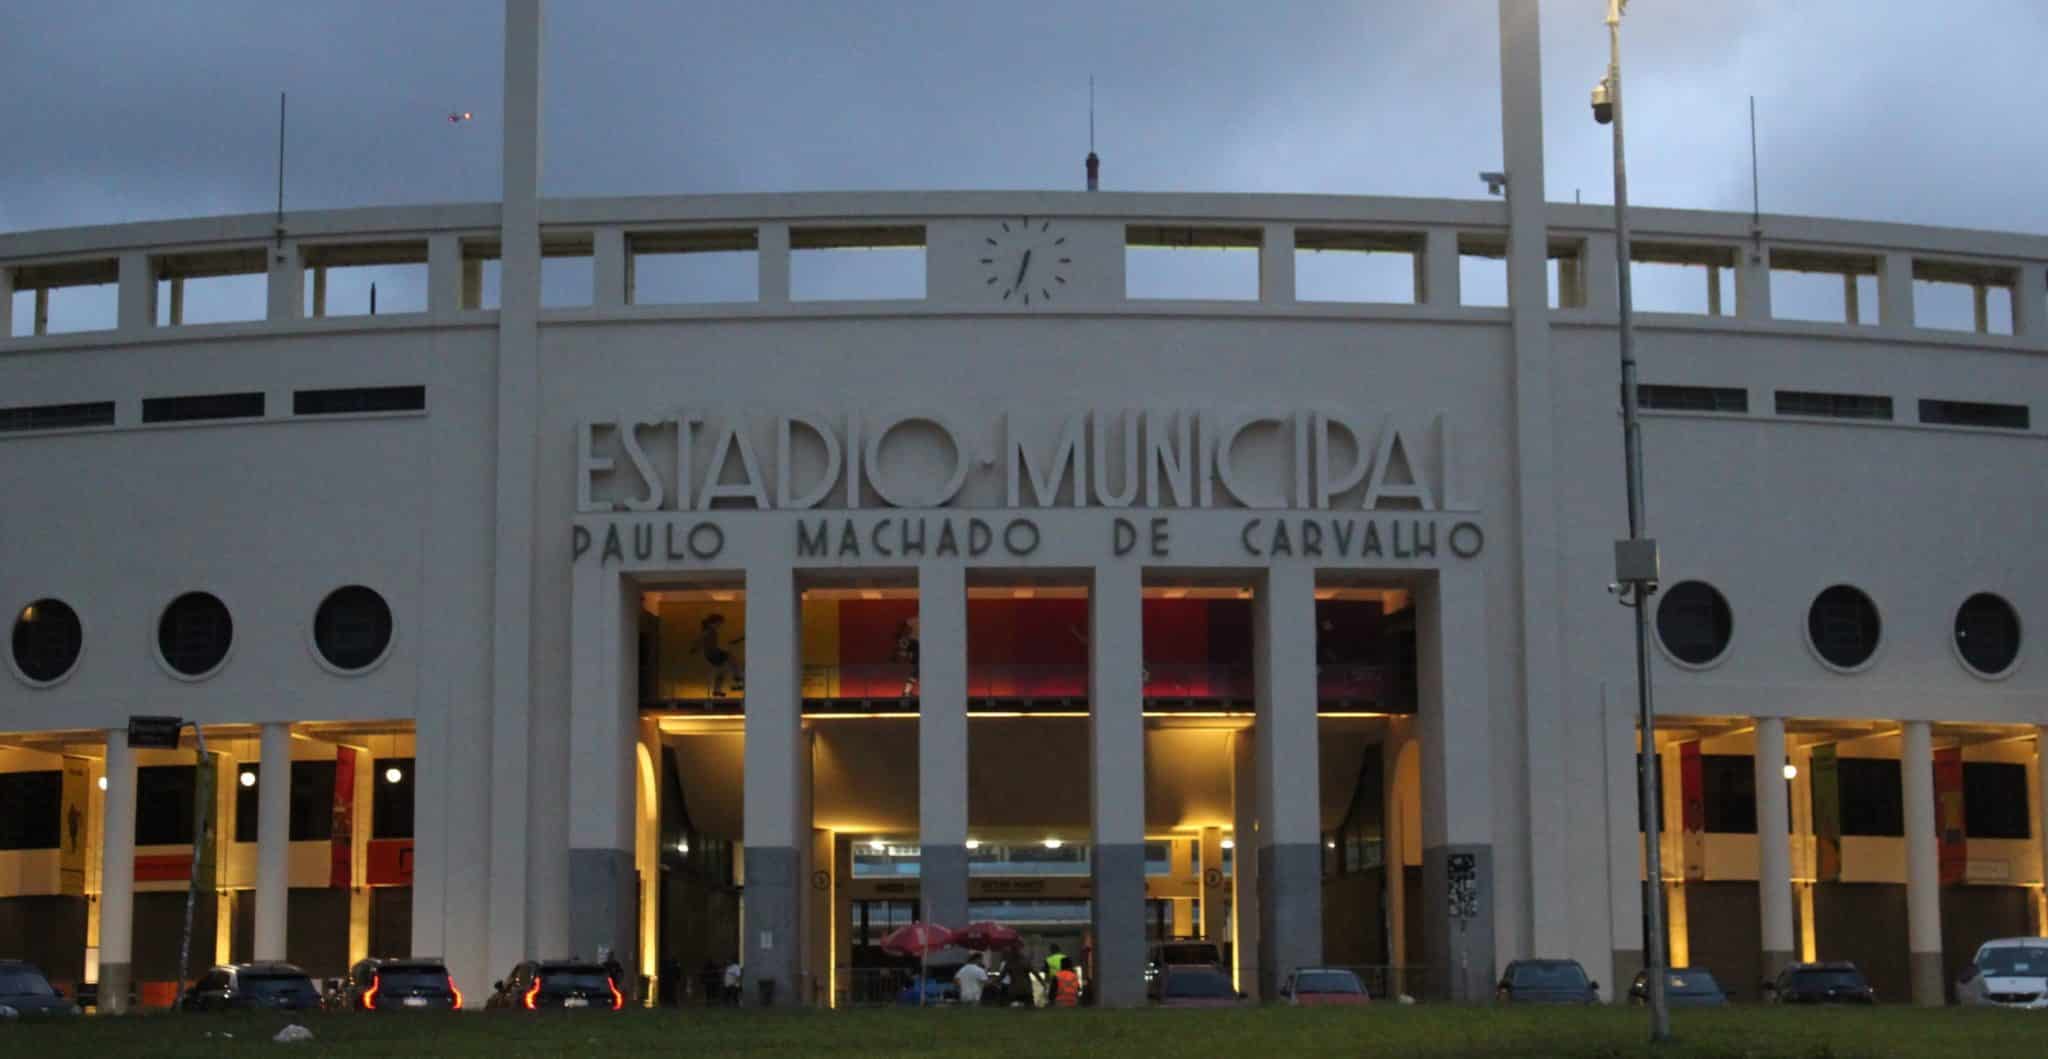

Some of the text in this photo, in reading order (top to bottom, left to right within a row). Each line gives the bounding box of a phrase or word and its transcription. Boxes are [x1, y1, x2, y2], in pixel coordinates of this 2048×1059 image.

[576, 409, 1481, 512] ESTADIO MUNICIPAL
[572, 517, 1485, 562] PAULO MACHADO DE CARVALHO
